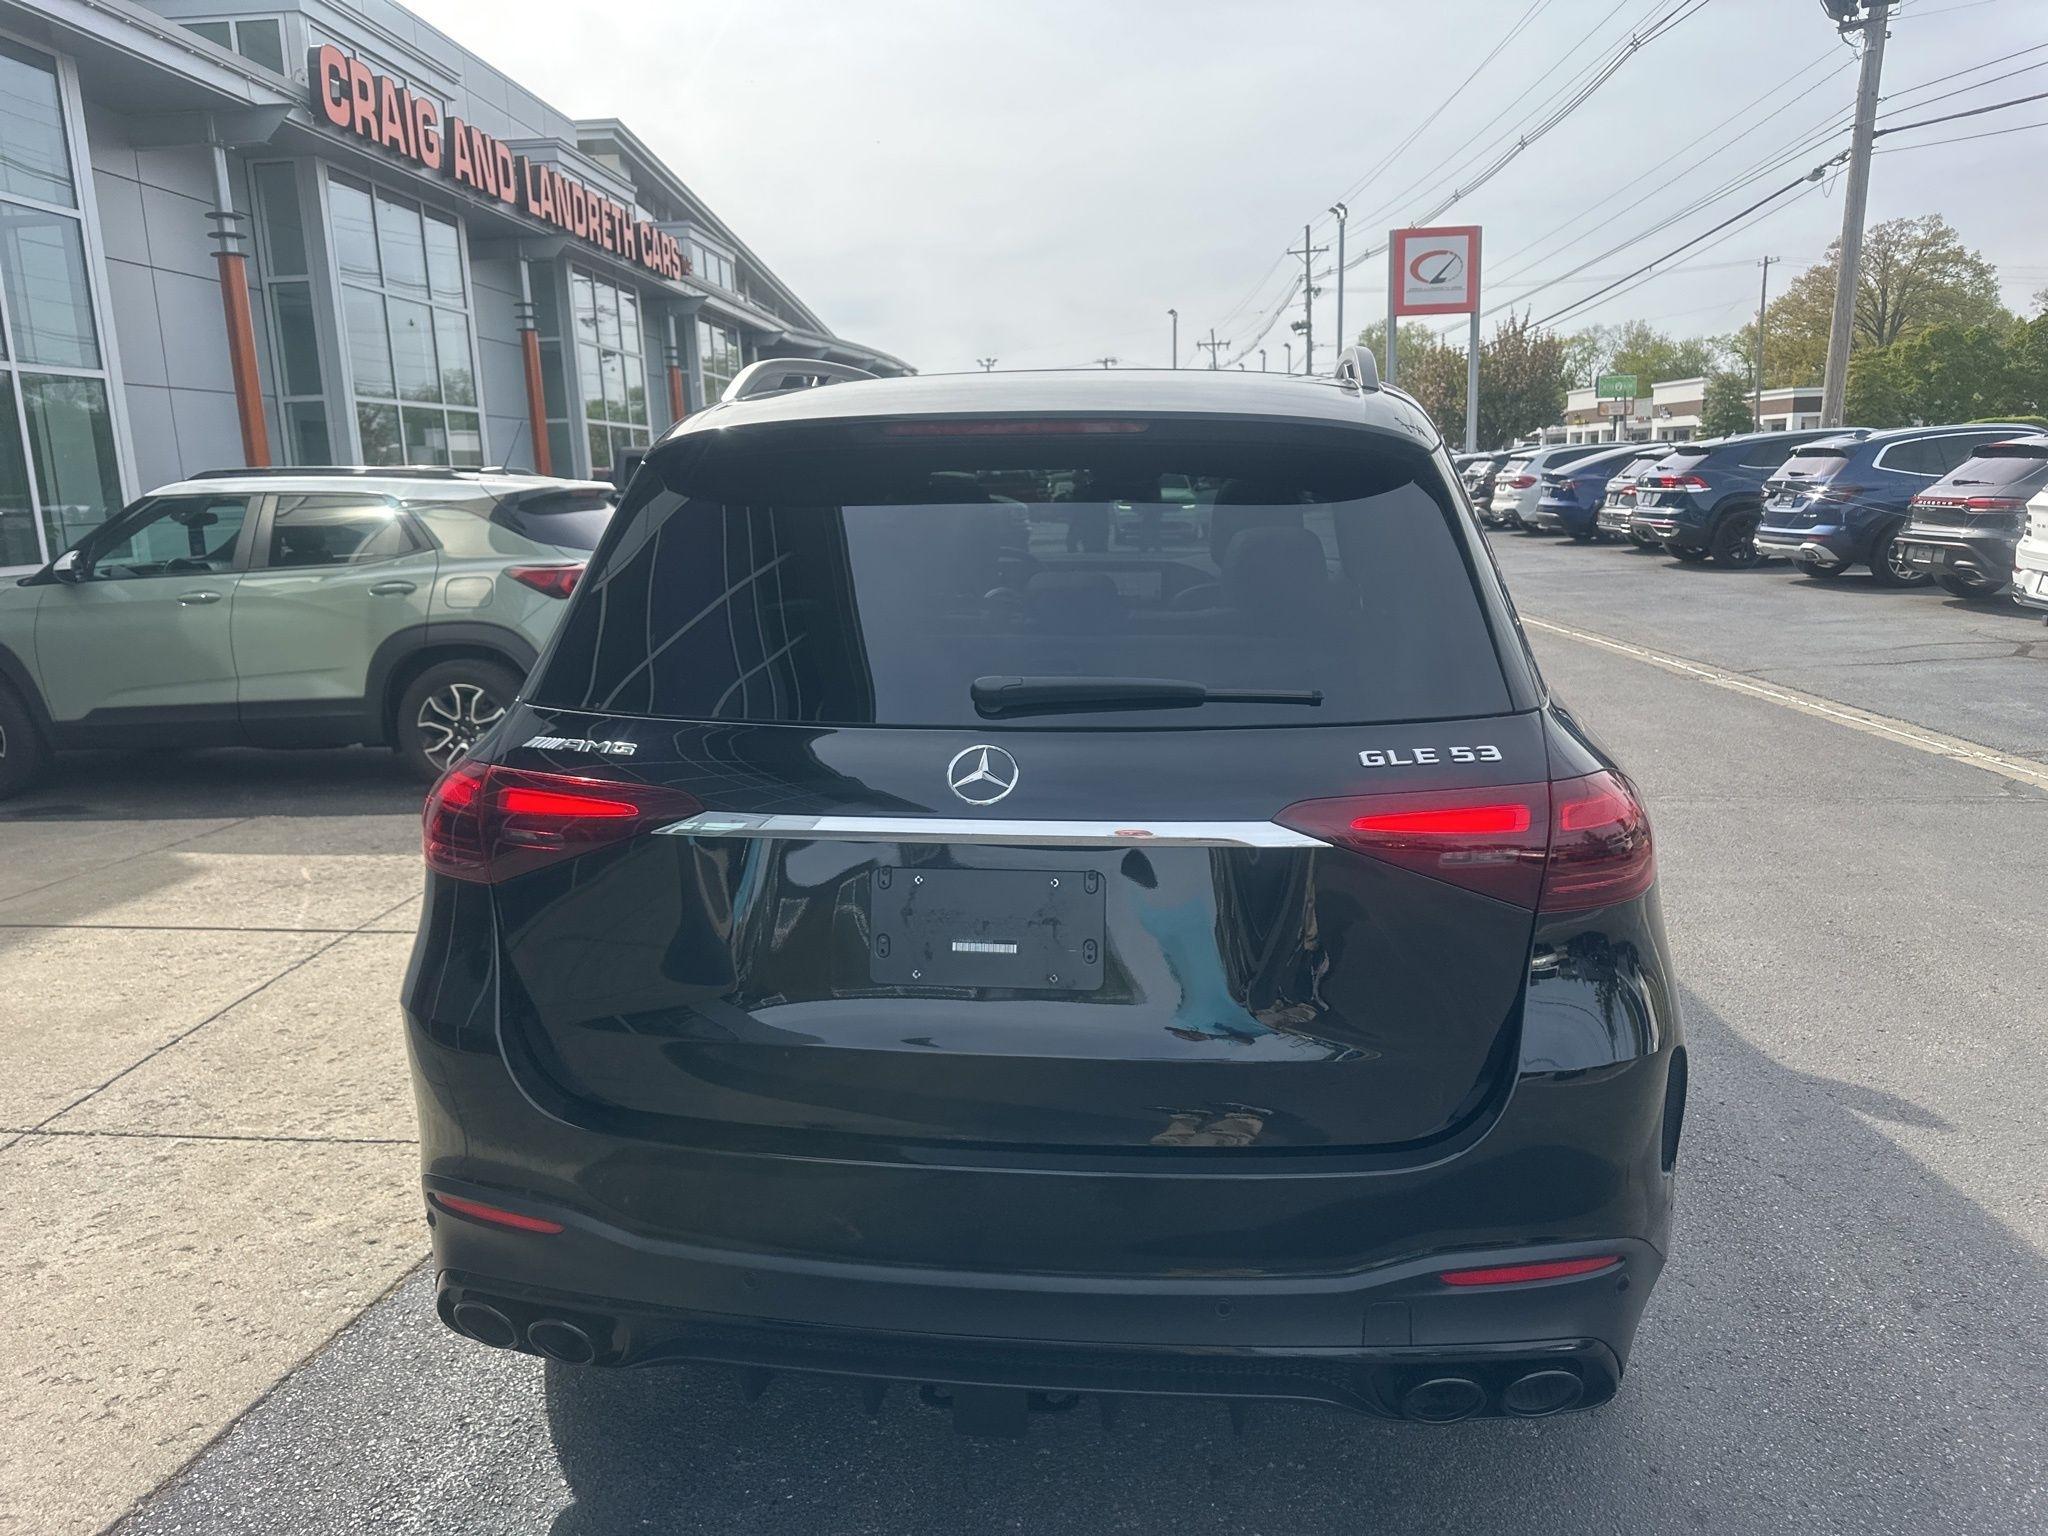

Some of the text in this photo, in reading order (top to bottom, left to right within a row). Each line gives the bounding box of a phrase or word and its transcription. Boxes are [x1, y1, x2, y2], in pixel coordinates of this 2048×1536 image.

[320, 44, 682, 281] CRAIG AND LANDRETH CARS
[1358, 745, 1503, 767] GLE 53
